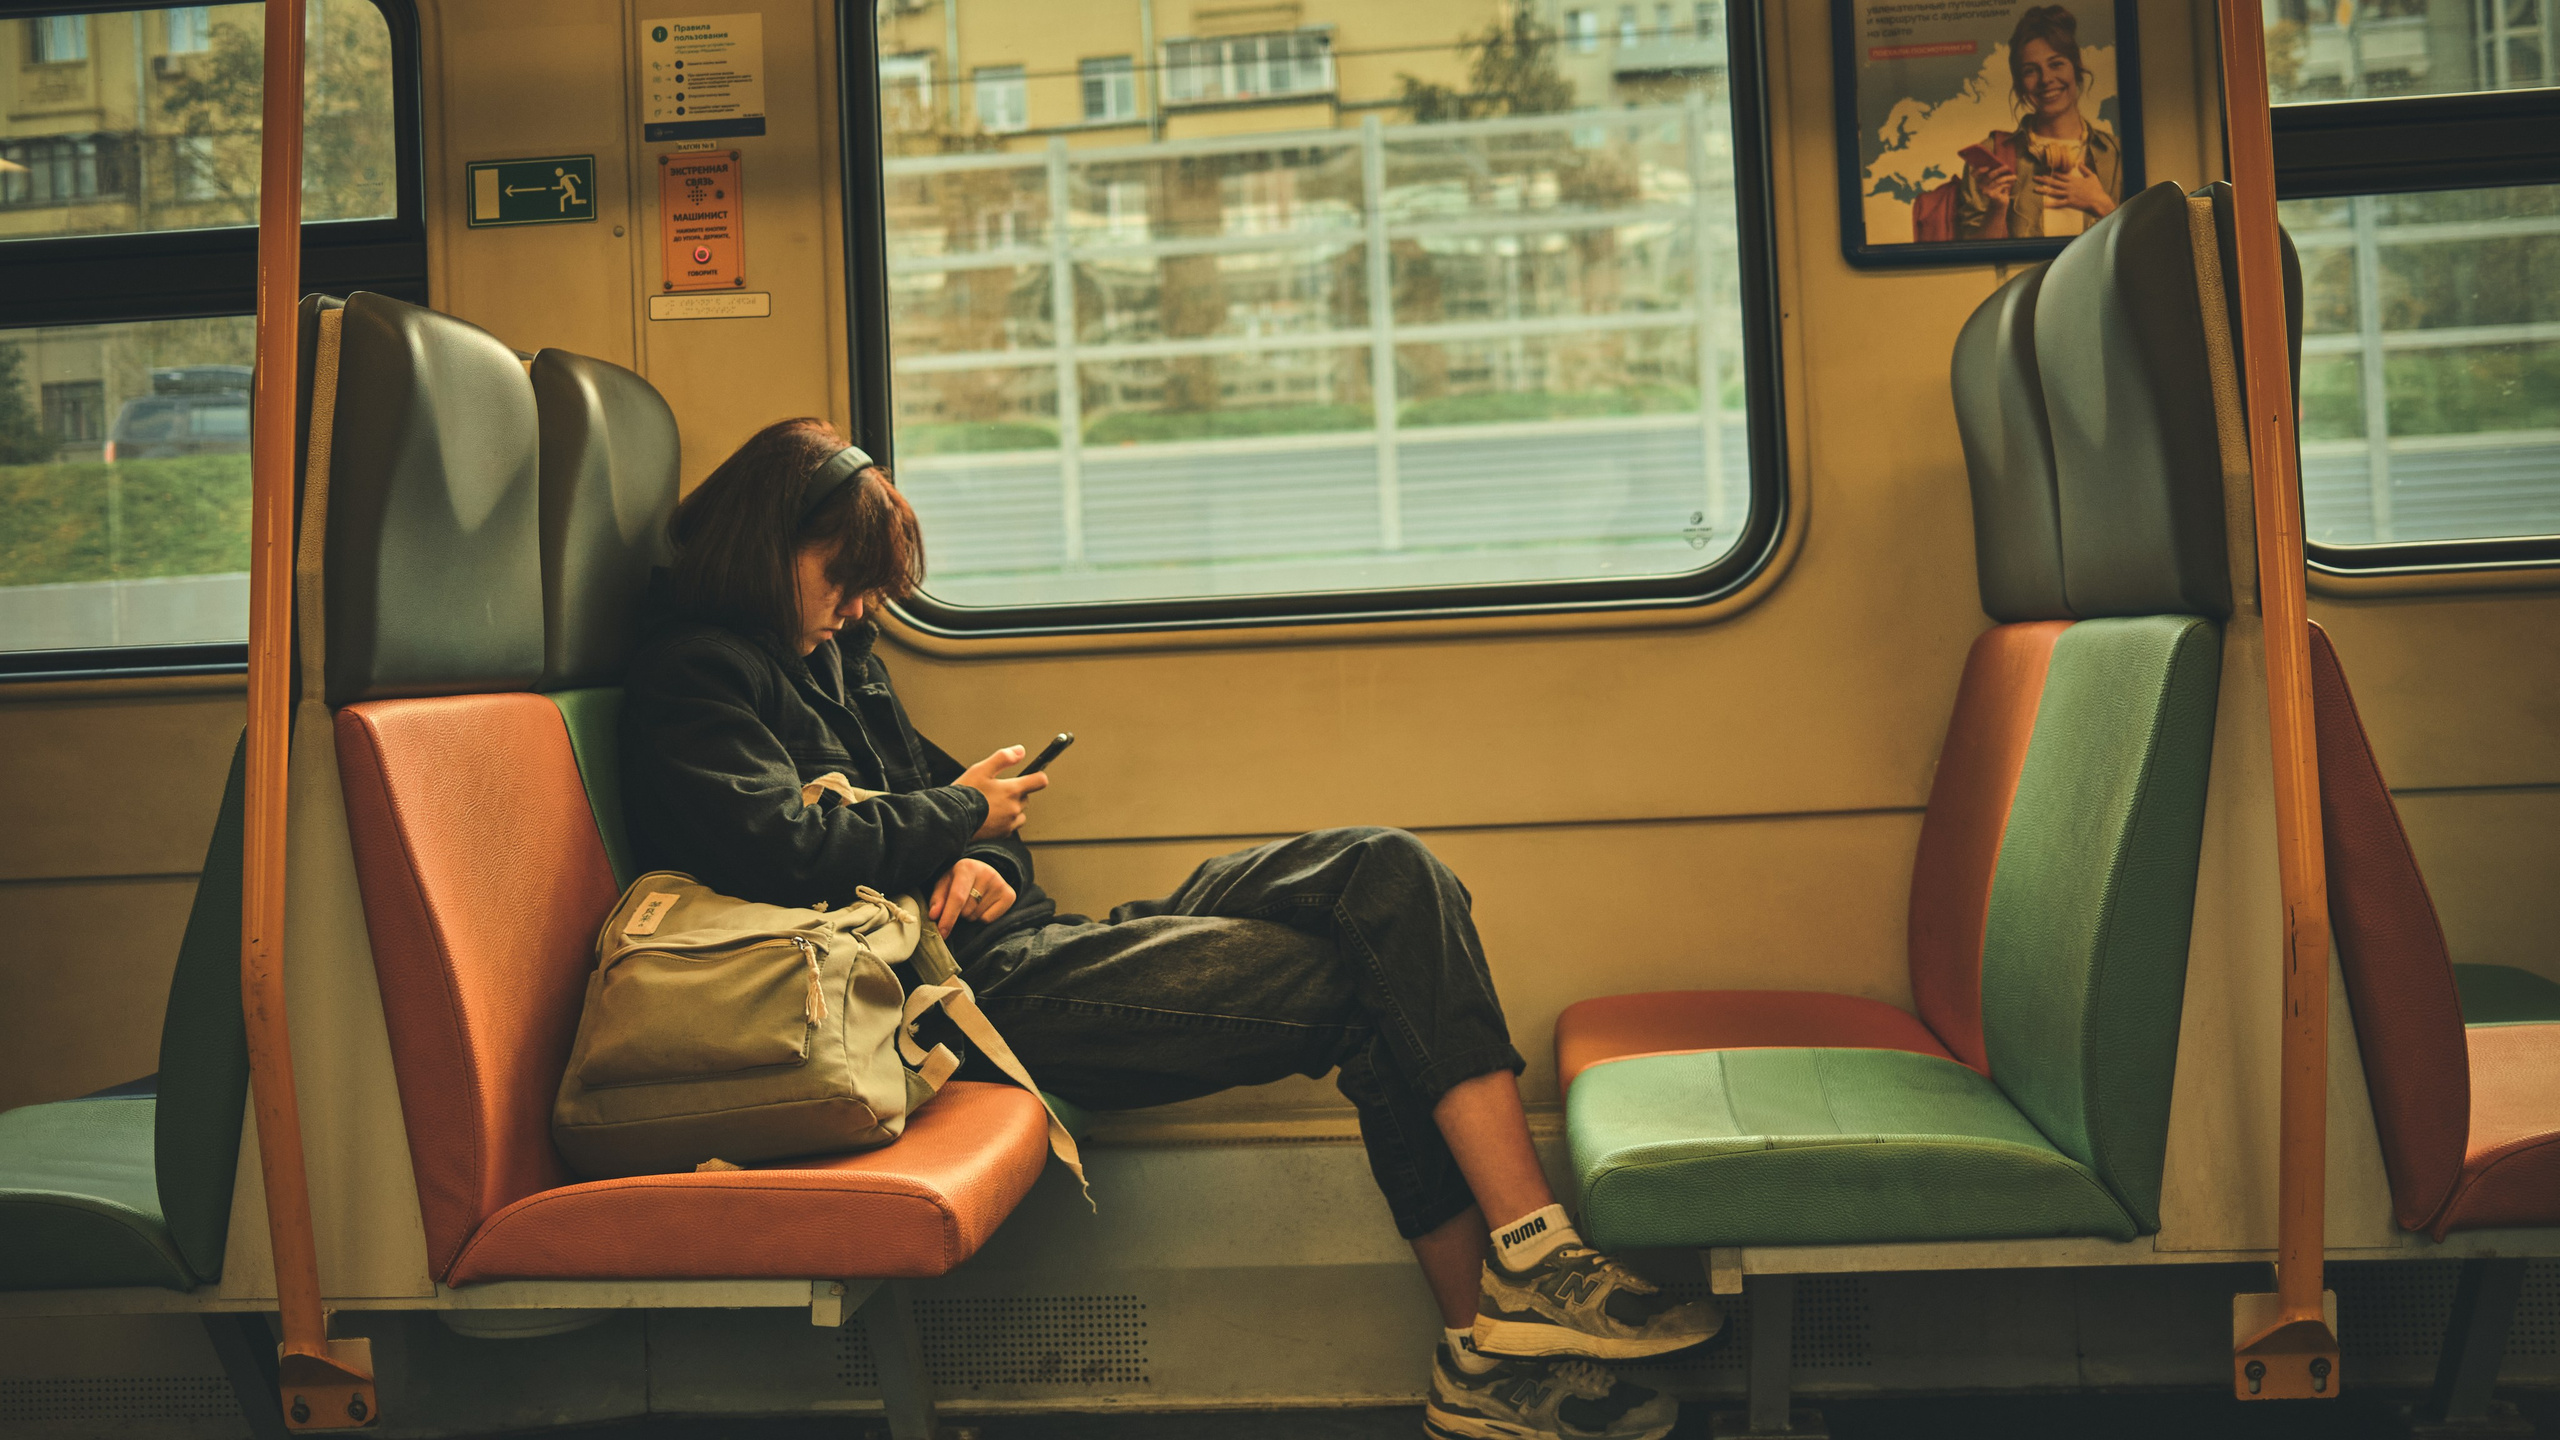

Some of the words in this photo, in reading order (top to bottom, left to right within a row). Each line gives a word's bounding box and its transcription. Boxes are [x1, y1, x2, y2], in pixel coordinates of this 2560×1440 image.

[1876, 14, 1931, 25] маршруты
[1932, 13, 1939, 21] с
[1941, 9, 2011, 22] аудиогидами
[673, 24, 711, 33] Правила
[1882, 28, 1913, 37] сайте
[678, 143, 699, 151] ВАГОН
[670, 164, 729, 176] ЭКСТРЕННАЯ
[685, 178, 714, 187] СВЯЗЬ
[673, 211, 728, 222] МАШИНИСТ
[688, 269, 718, 277] ГОВОРИТЕ
[1502, 1216, 1547, 1249] PUMA
[1555, 1271, 1600, 1305] N
